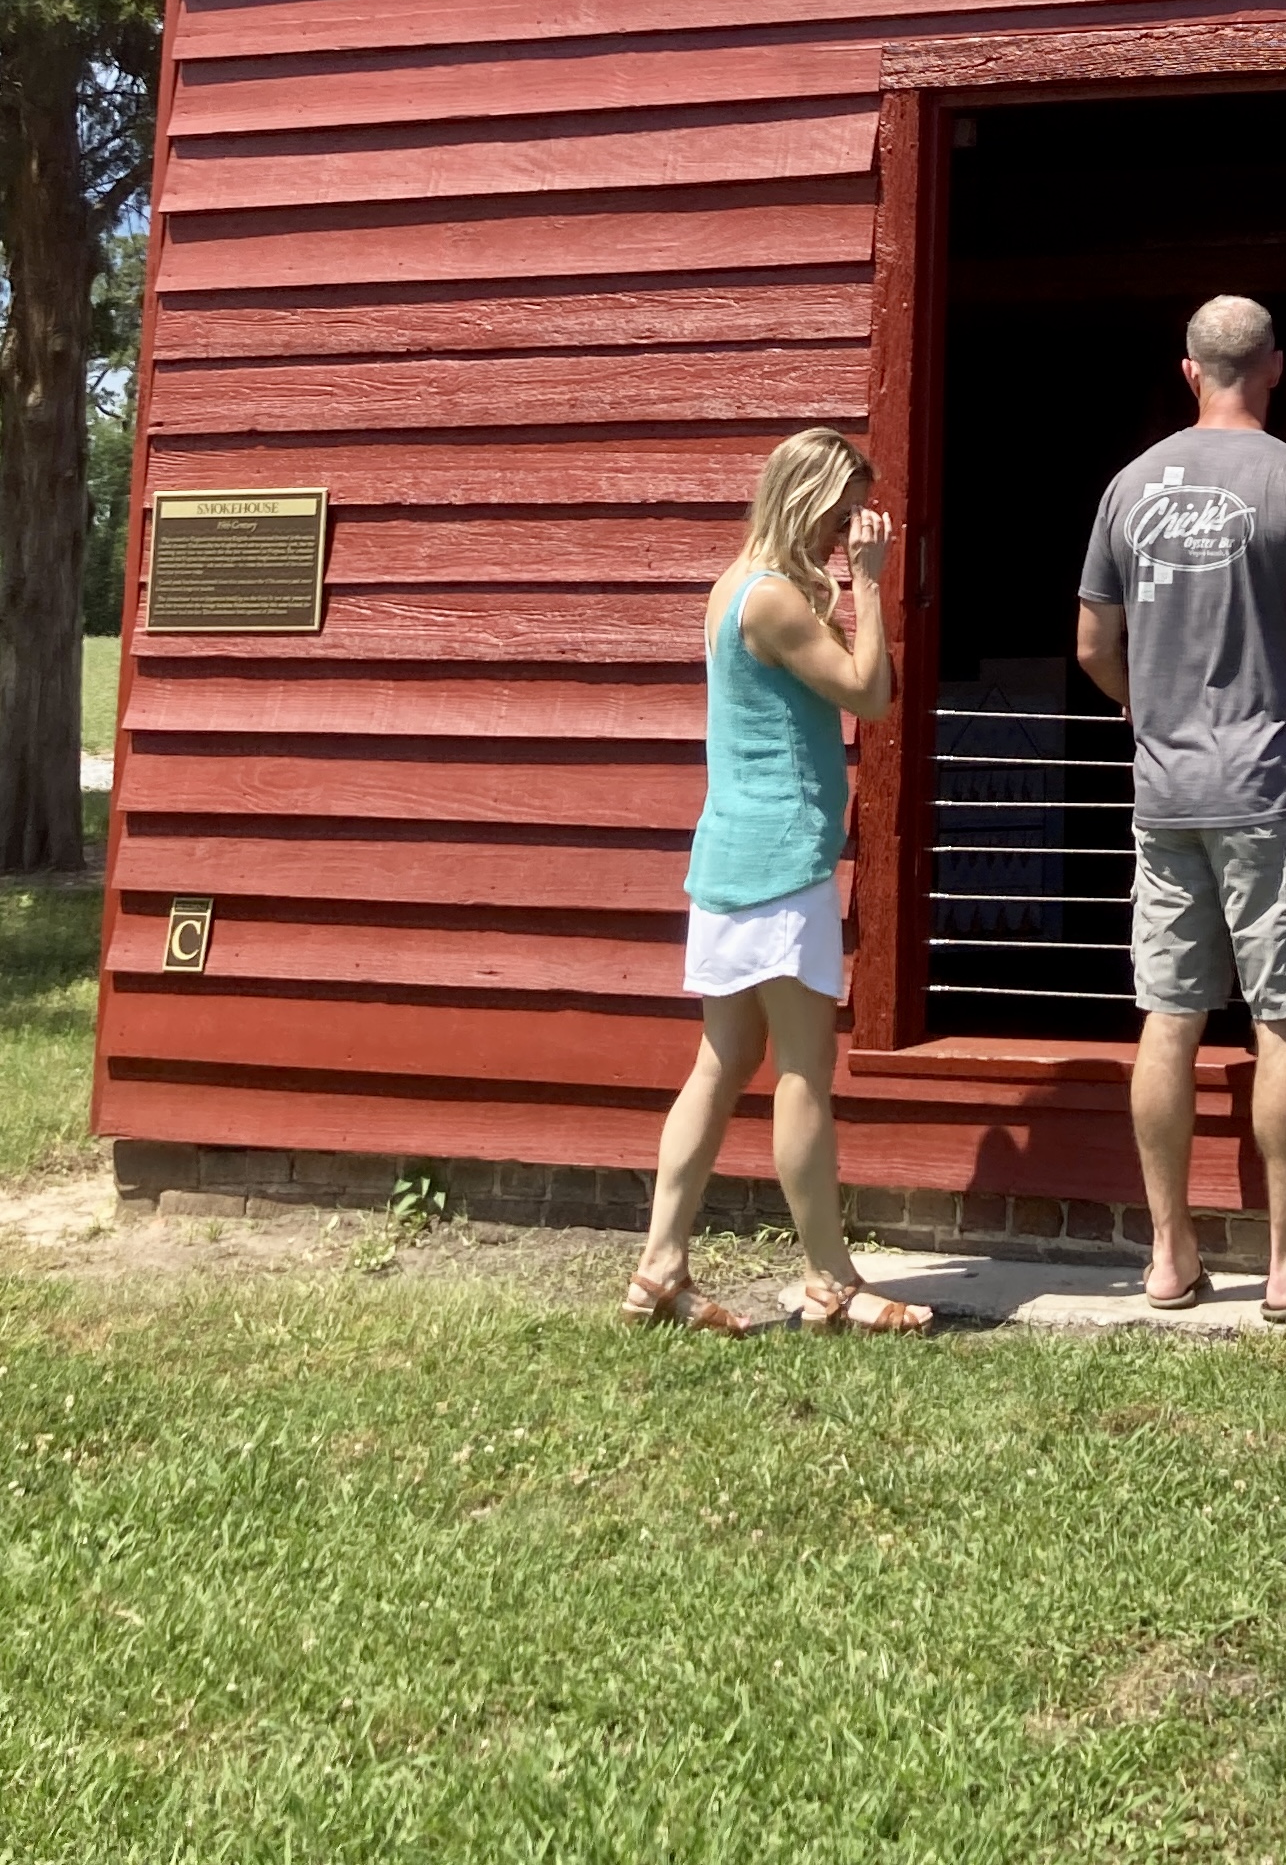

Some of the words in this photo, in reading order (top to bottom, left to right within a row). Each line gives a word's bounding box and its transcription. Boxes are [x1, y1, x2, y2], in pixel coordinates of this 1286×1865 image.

[197, 502, 279, 515] SMOKEHOUSE
[1133, 493, 1256, 555] Chick's
[1183, 536, 1218, 550] Oyster
[171, 919, 202, 961] C
